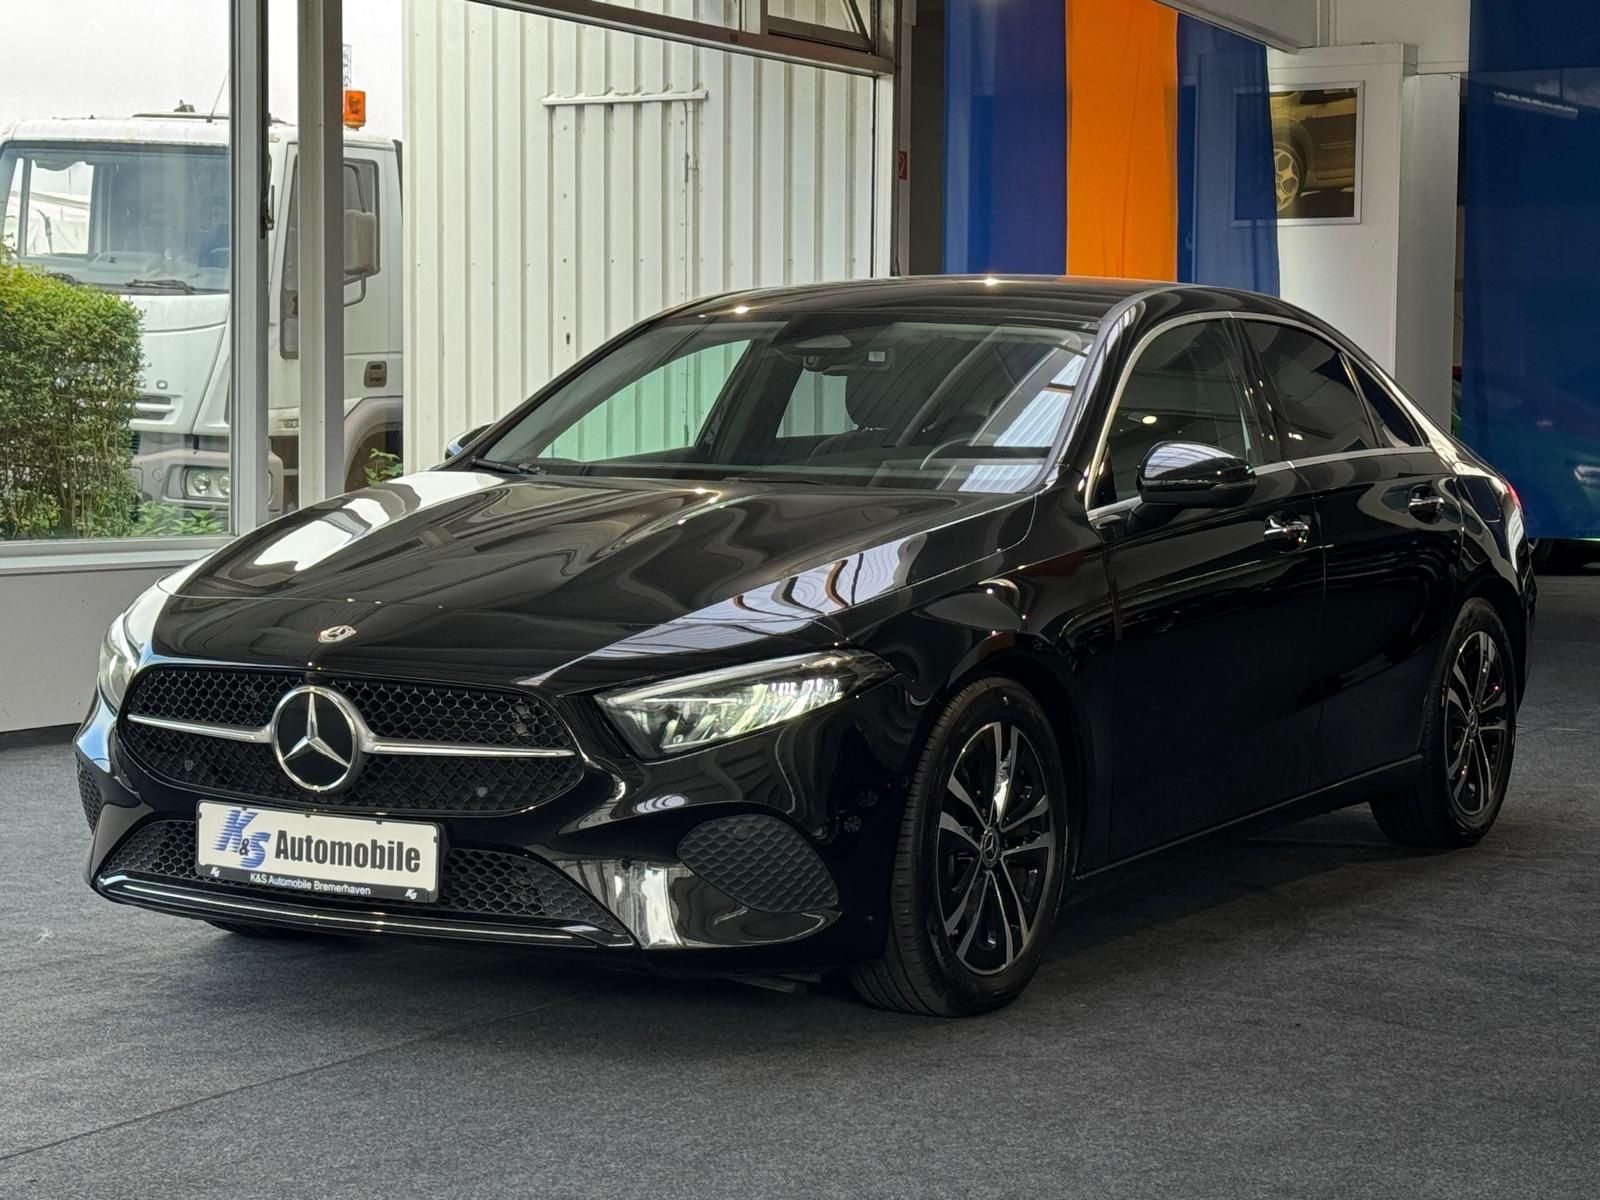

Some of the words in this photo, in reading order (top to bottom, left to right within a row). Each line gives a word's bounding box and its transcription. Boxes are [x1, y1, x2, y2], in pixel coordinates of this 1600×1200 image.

[213, 809, 271, 869] K&S
[274, 830, 421, 873] Automobile
[250, 872, 267, 884] K&S
[268, 875, 312, 890] Automobile
[314, 881, 371, 895] Bremerhaven
